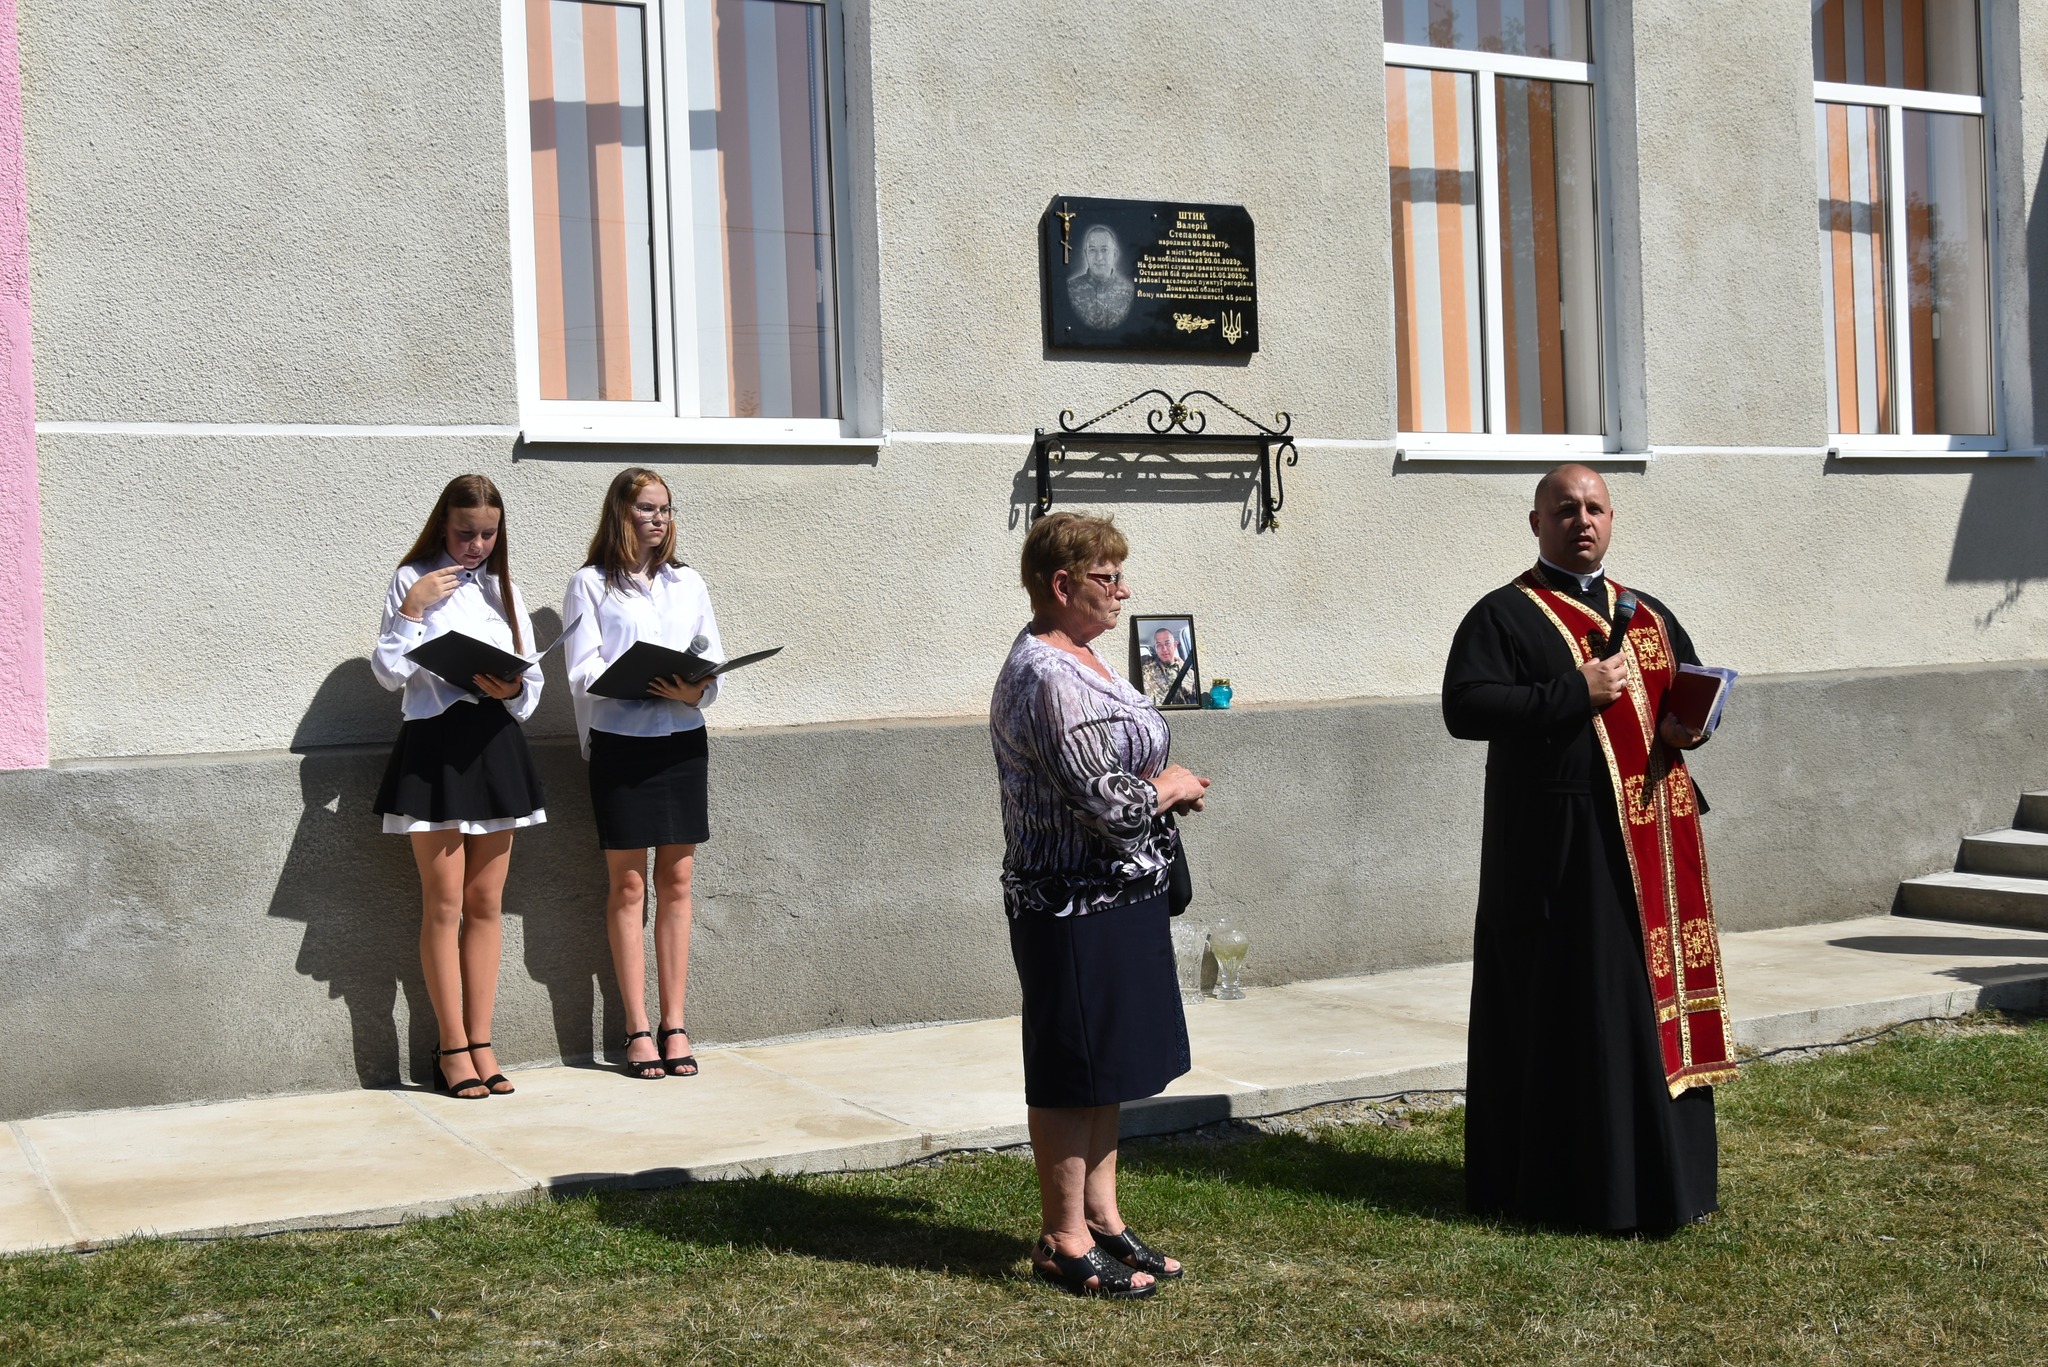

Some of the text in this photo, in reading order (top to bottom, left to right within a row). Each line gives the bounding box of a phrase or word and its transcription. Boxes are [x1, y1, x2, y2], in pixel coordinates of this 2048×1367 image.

[1178, 212, 1205, 220] ШТИК
[1176, 221, 1208, 231] Валерій
[1169, 230, 1216, 240] Степанович
[1137, 290, 1154, 299] Йому
